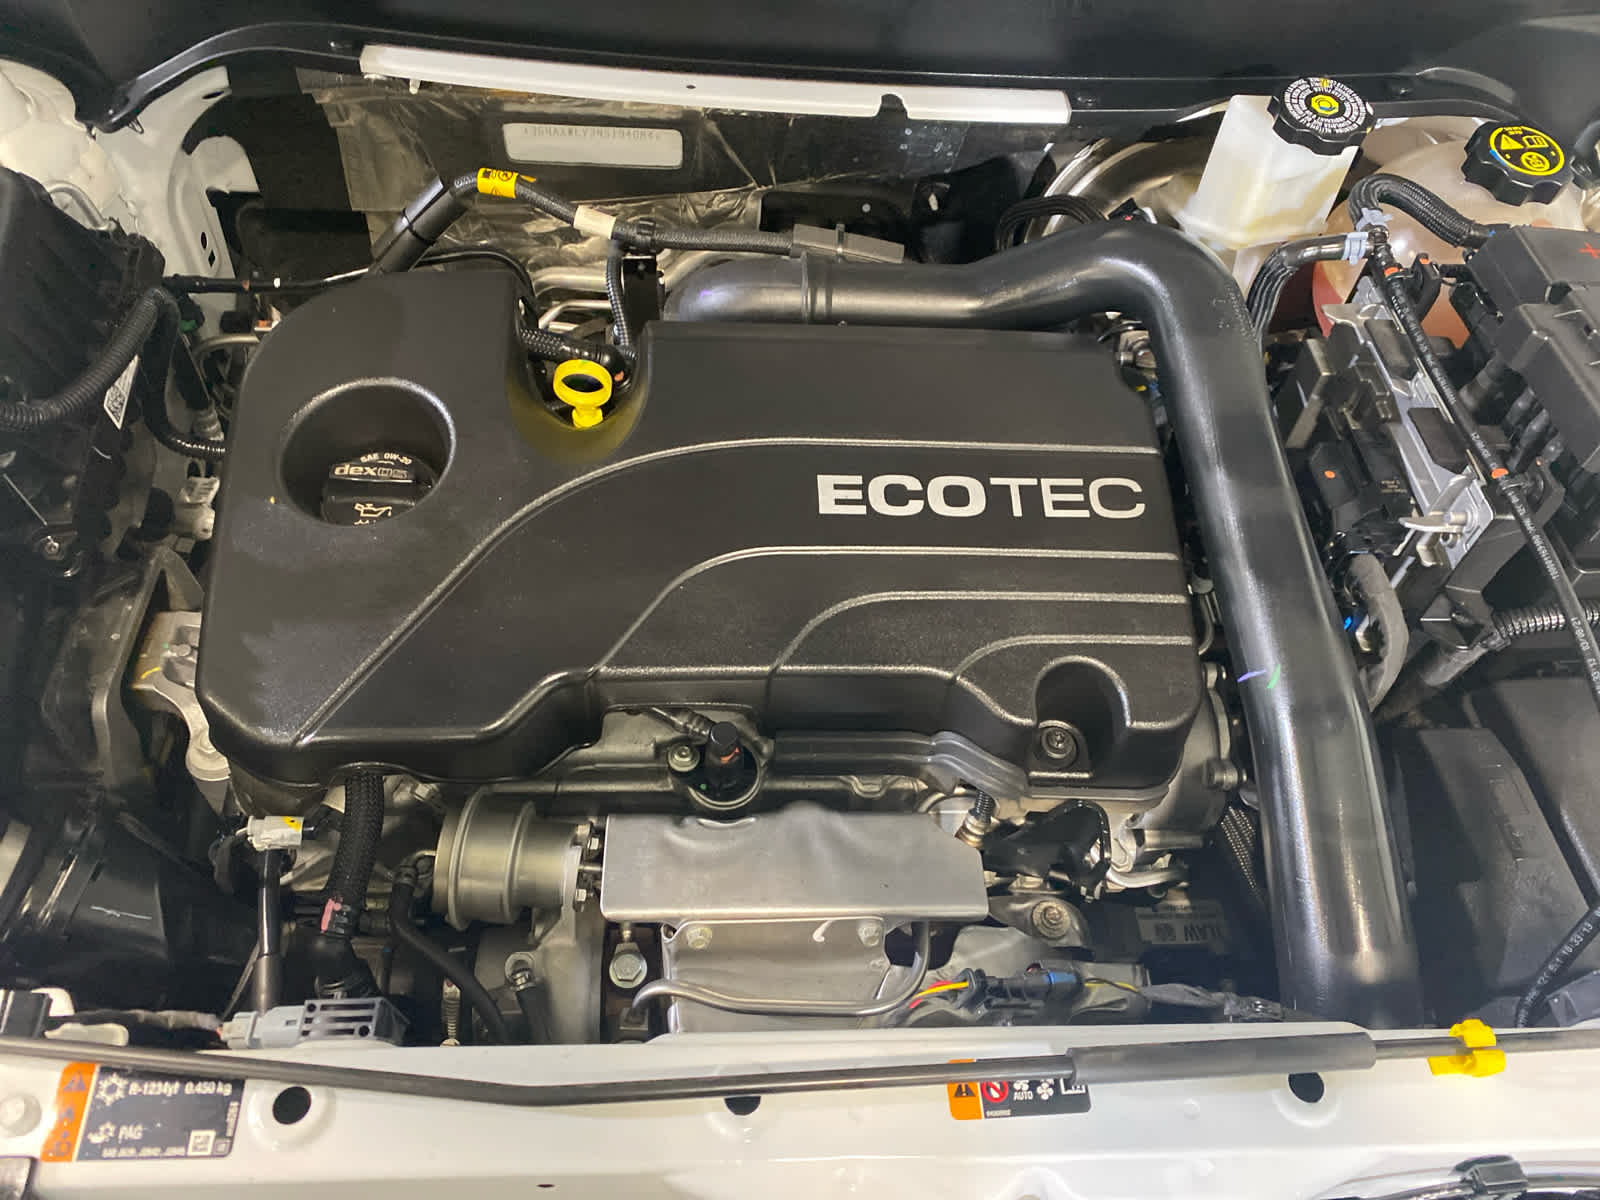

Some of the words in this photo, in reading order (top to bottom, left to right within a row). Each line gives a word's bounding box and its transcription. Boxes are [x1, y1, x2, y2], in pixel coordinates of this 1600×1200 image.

[360, 453, 379, 463] SAE
[816, 474, 1146, 519] ECOTEC
[128, 1082, 180, 1097] R-1234yf
[217, 1081, 232, 1097] kg
[1013, 1091, 1033, 1101] AUTO
[118, 1125, 144, 1143] PAG
